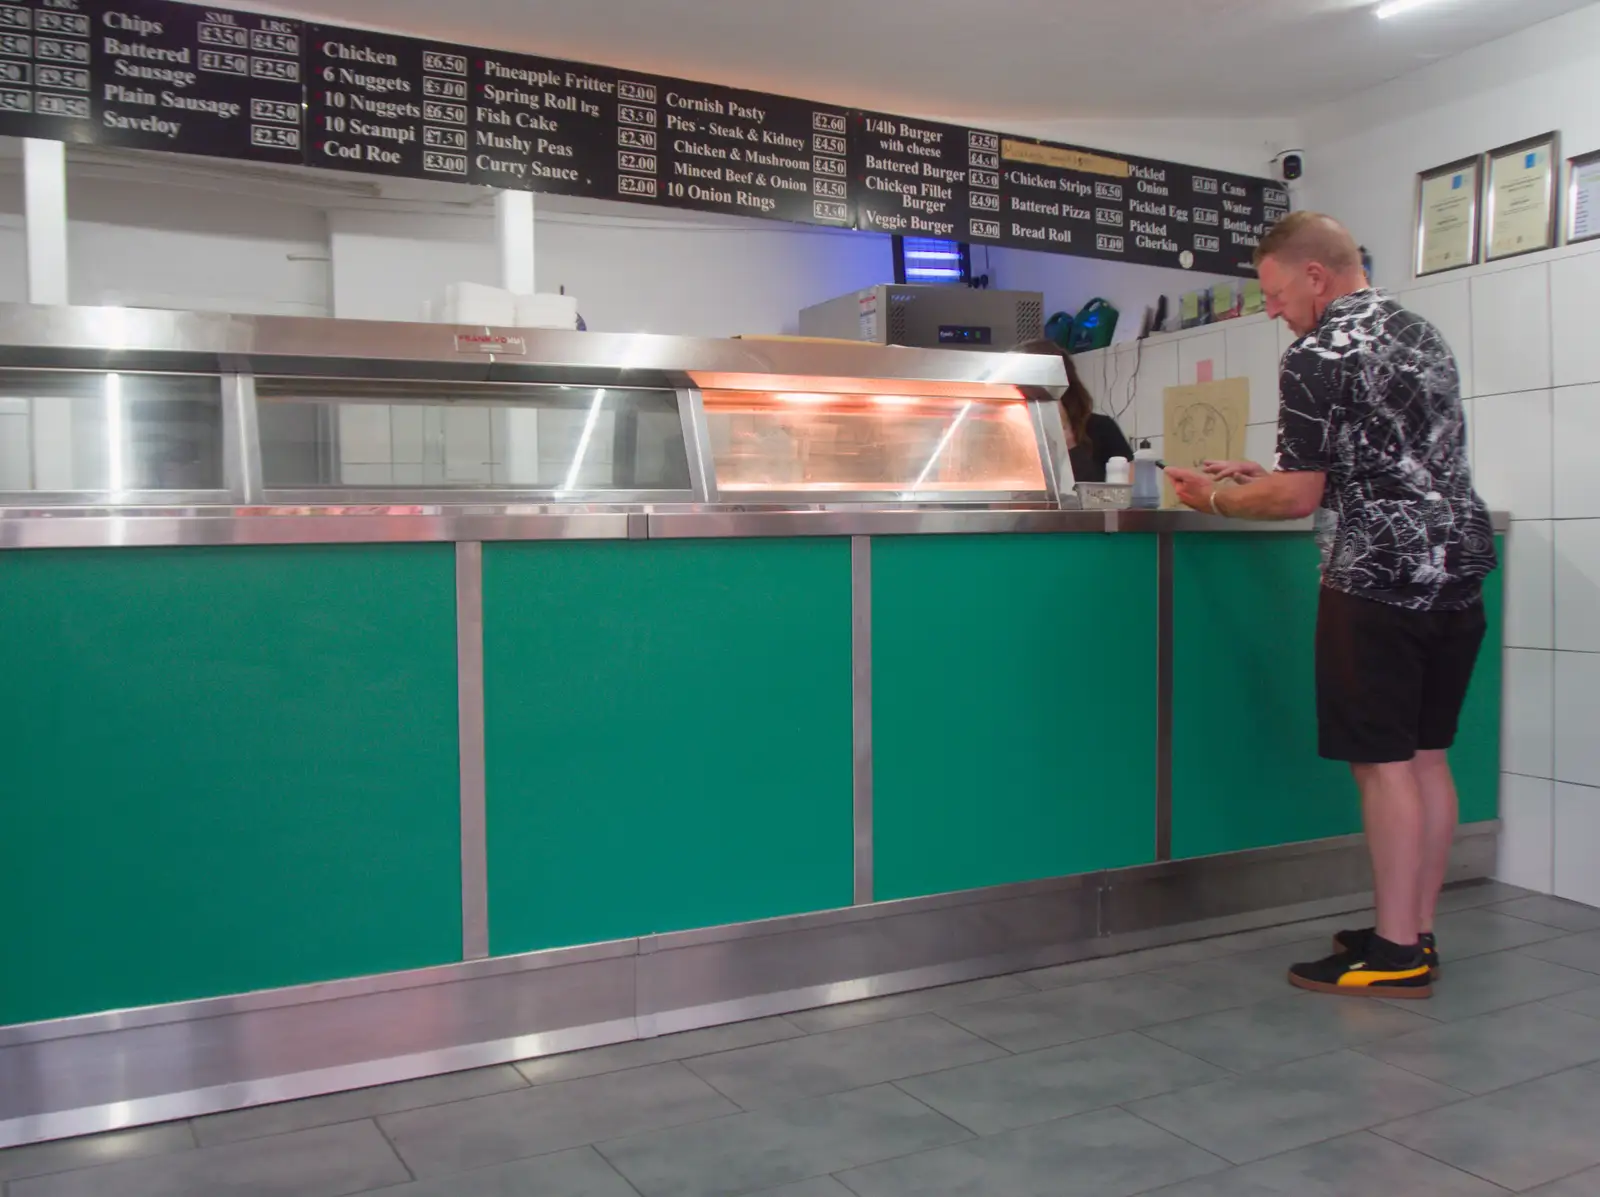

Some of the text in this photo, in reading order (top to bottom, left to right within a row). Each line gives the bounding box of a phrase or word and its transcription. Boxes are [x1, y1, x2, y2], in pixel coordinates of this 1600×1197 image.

[103, 11, 163, 36] Chips
[205, 11, 292, 34] SML LRG
[104, 37, 190, 63] Battered
[202, 28, 298, 53] £3.50 £4.50
[323, 41, 398, 66] Chicken
[425, 54, 464, 72] £6.50
[115, 59, 197, 87] Sausage
[202, 55, 298, 80] £1.50 £2.50
[323, 66, 411, 92] 6 Nuggets
[484, 60, 615, 94] Pineapple Fritter
[104, 84, 241, 118] Plain Sausage
[484, 84, 600, 117] Spring Roll lrg
[620, 84, 654, 101] £2.00
[254, 104, 298, 121] £2.50
[325, 91, 421, 118] 10 Nuggets
[425, 104, 464, 122] £6.50
[620, 108, 654, 124] £3.50
[666, 92, 766, 124] Cornish Pasty
[103, 110, 182, 138] Saveloy
[325, 116, 416, 144] 10 Scampi
[476, 106, 559, 132] Fish Cake
[815, 115, 844, 131] £2.60
[254, 129, 298, 147] £2.50
[425, 129, 464, 147] £7.50
[620, 131, 654, 148] £2.30
[666, 114, 696, 132] Pies
[709, 122, 744, 140] Steak
[747, 128, 759, 142] &
[763, 130, 805, 152] Kidney
[866, 118, 943, 144] 1/4lb Burger
[323, 141, 401, 164] Cod Roe
[476, 130, 573, 157] Mushy Peas
[815, 136, 845, 153] £4.50
[880, 140, 941, 158] with cheese
[425, 154, 464, 172] £3.00
[620, 154, 654, 170] £2.00
[674, 140, 810, 171] Chicken & Mushroom
[815, 158, 845, 174] £4.50
[476, 154, 579, 181] Curry Sauce
[674, 162, 807, 192] Minced Beef & Onion
[866, 155, 966, 183] Battered Burger
[1128, 164, 1166, 182] Pickled
[620, 178, 654, 195] £2.00
[815, 181, 845, 197] £4.50
[865, 176, 953, 200] Chicken Fillet
[1010, 170, 1056, 189] Chicken
[1060, 178, 1092, 196] Strips
[1137, 181, 1169, 196] Onion
[1222, 182, 1246, 197] Cans
[667, 182, 776, 212] 10 Onion Rings
[903, 195, 946, 214] Burger
[971, 195, 998, 209] £4.90
[1011, 197, 1091, 220] Battered Pizza
[1222, 199, 1252, 215] Water
[1129, 199, 1188, 222] Pickled Egg
[866, 210, 954, 235] Veggie Burger
[972, 221, 999, 236] £3.00
[1012, 223, 1072, 243] Bread Roll
[1129, 220, 1167, 237] Pickled
[1223, 217, 1252, 233] Bottle
[1135, 235, 1178, 252] Gherkin
